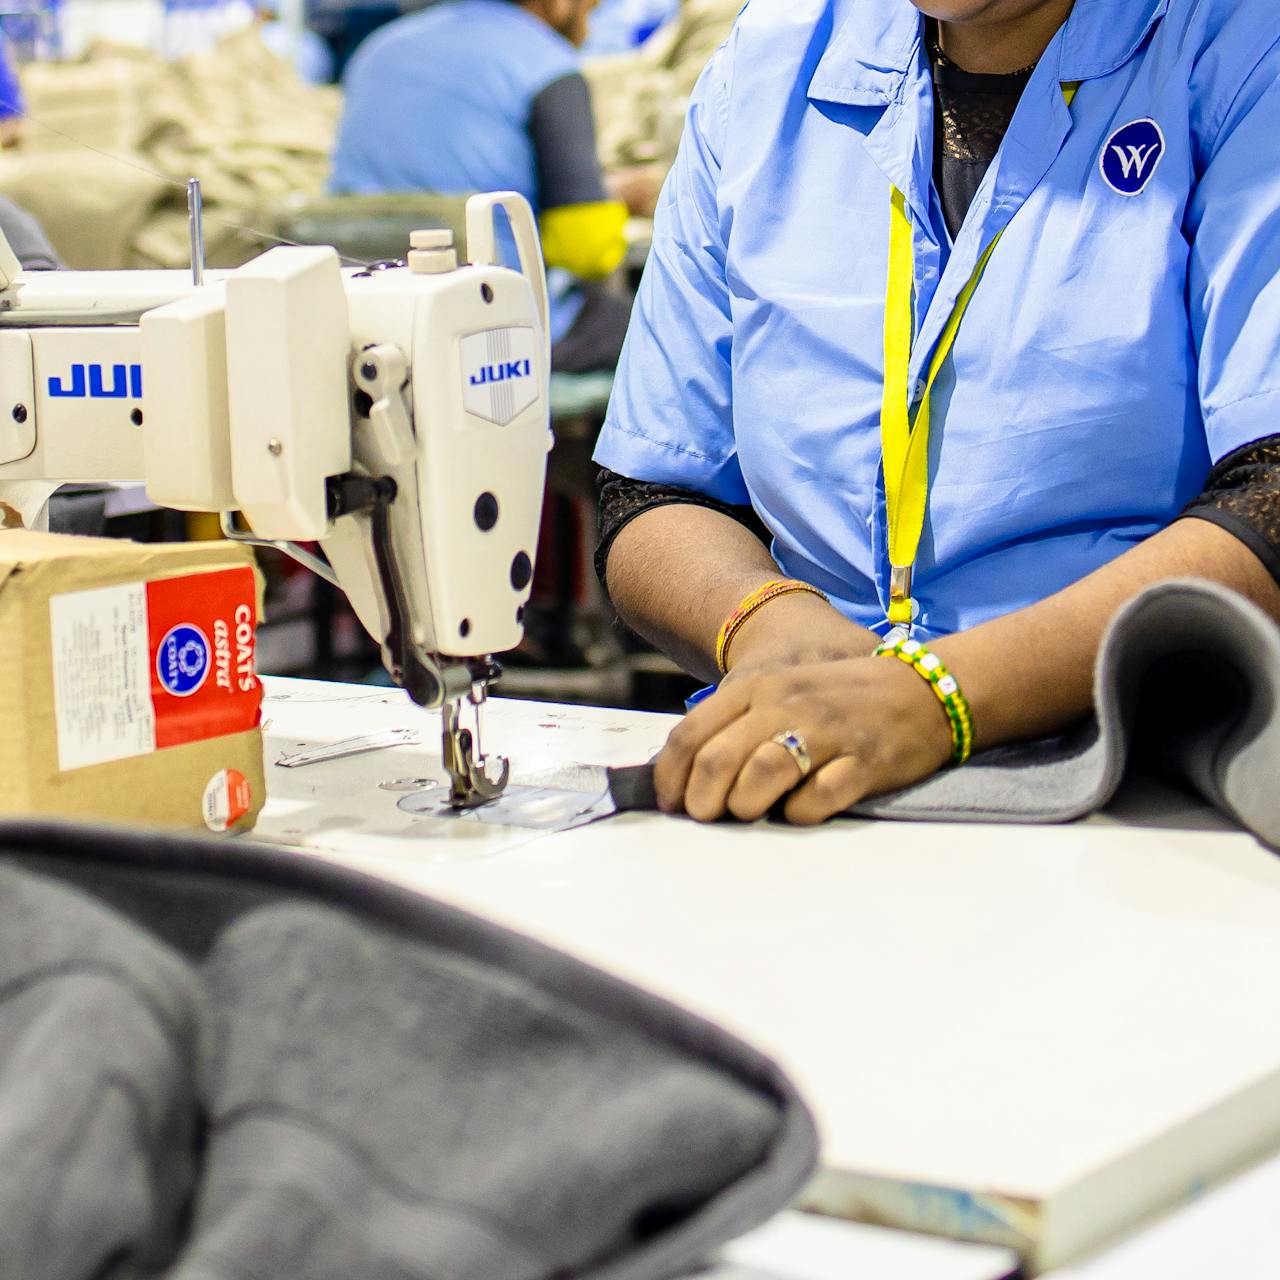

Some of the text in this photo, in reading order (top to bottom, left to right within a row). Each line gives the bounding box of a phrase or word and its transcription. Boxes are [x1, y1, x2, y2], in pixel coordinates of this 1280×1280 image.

[1111, 142, 1159, 178] W
[470, 359, 530, 386] JUKI
[167, 635, 179, 689] COATS
[235, 604, 256, 692] COATS
